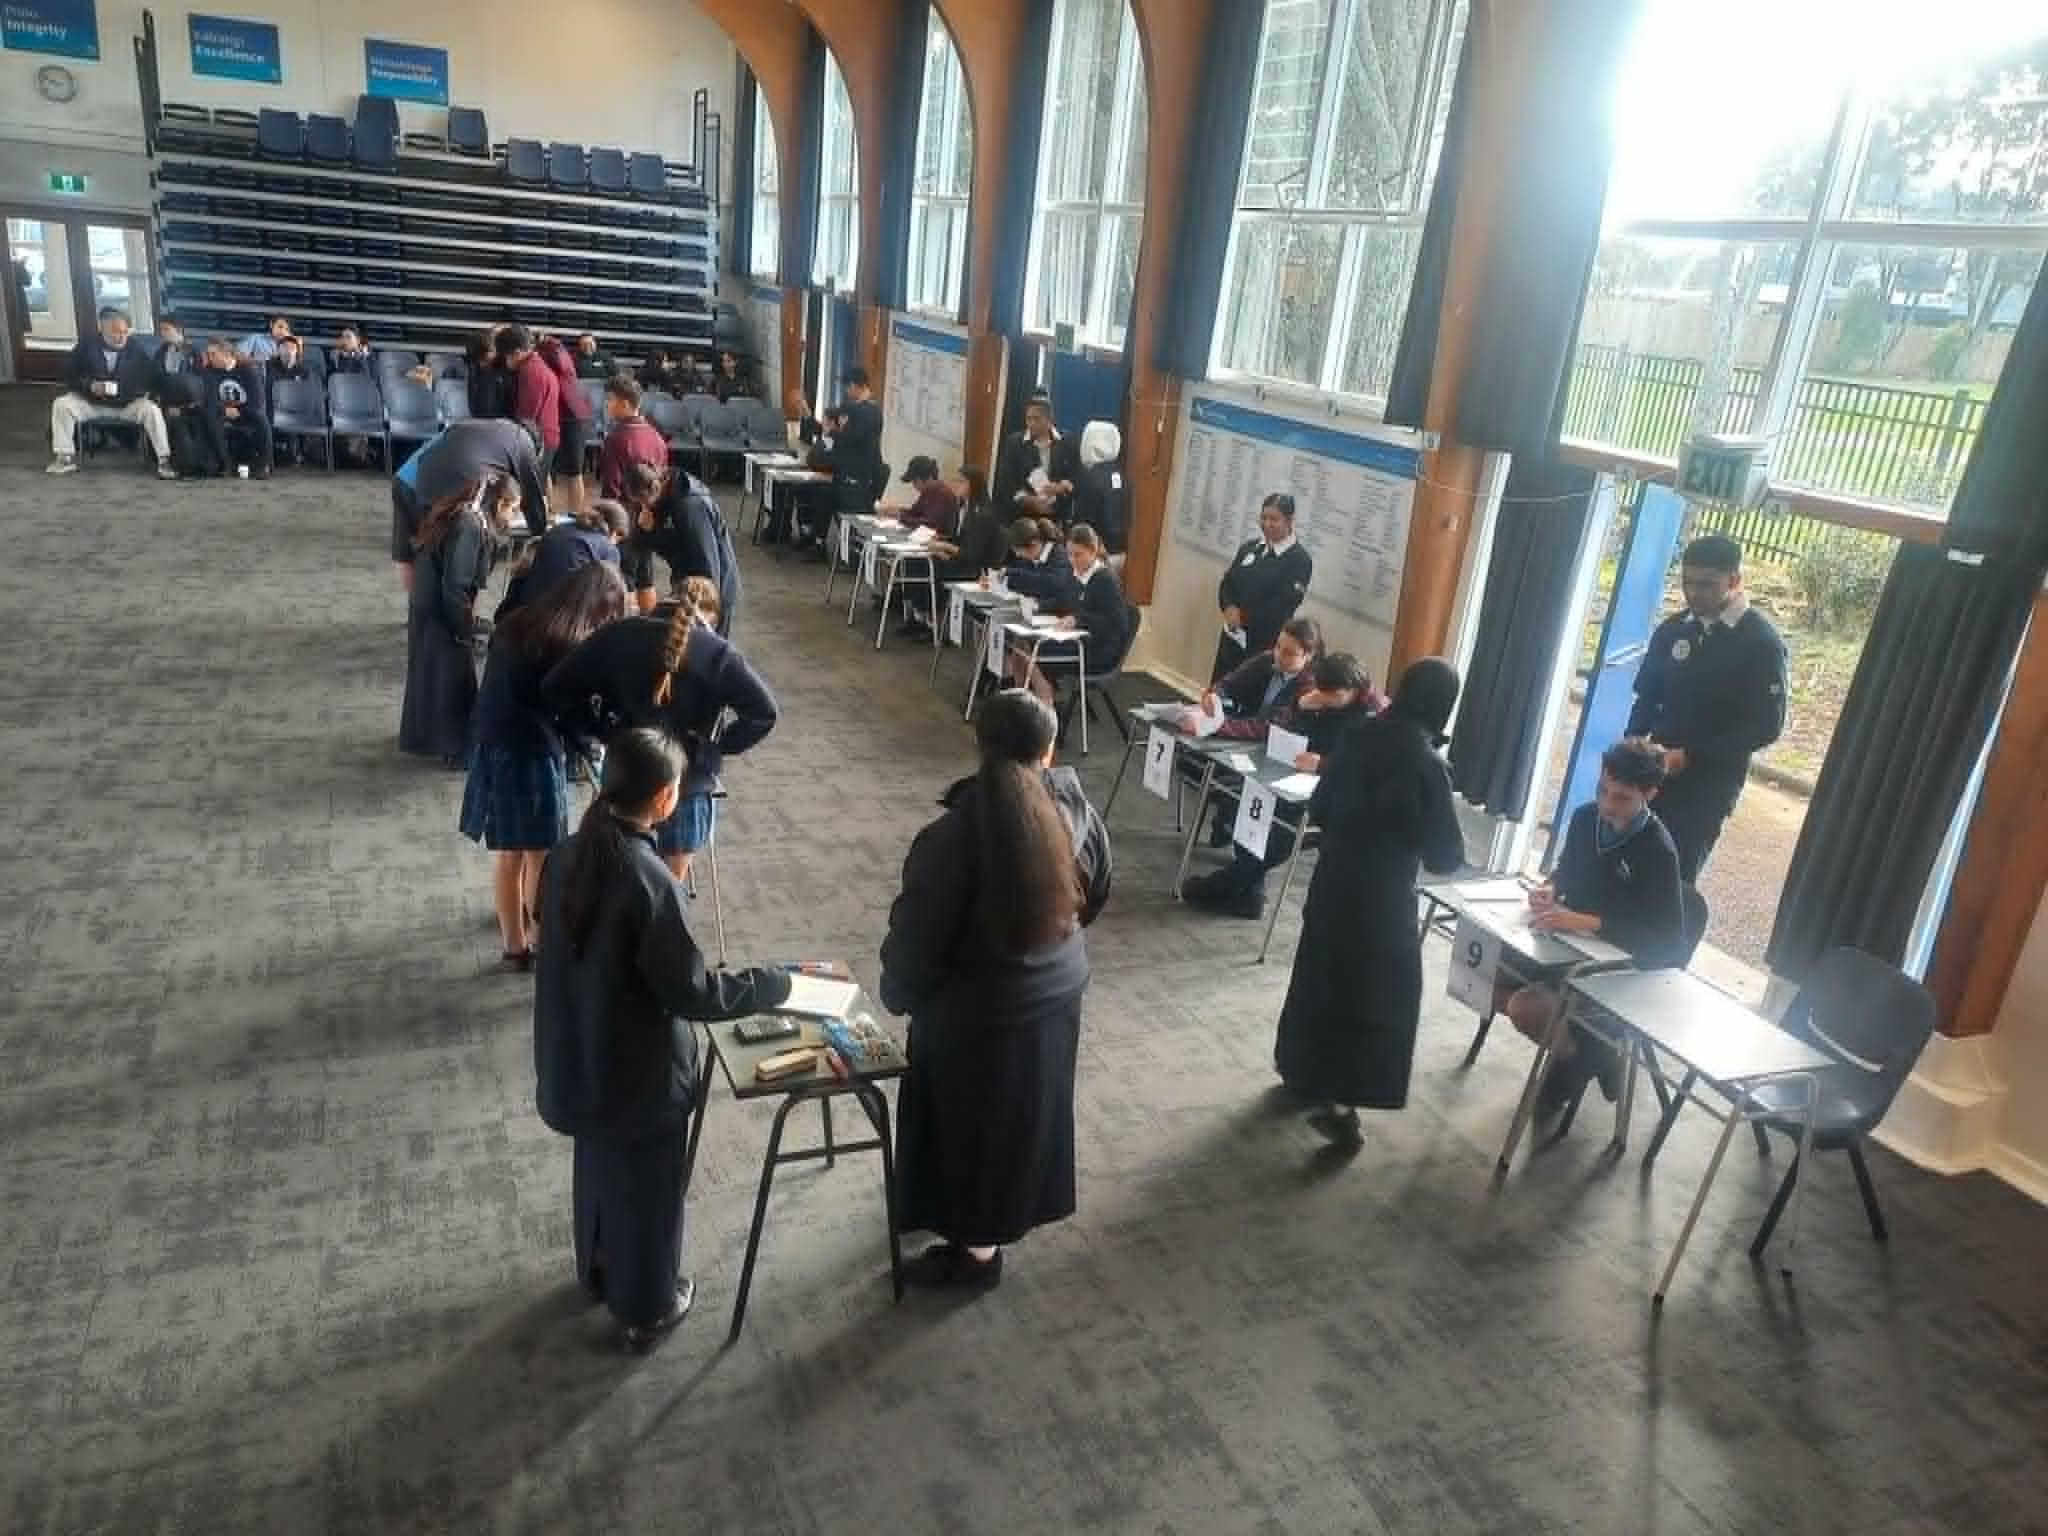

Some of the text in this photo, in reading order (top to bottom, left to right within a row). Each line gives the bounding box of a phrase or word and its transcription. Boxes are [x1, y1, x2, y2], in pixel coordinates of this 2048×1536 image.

[7, 19, 68, 40] Integrity
[196, 44, 265, 65] Excellence
[1684, 451, 1746, 498] EXIT
[1154, 741, 1166, 762] 7
[1248, 796, 1264, 820] 8
[1467, 940, 1483, 968] 9
